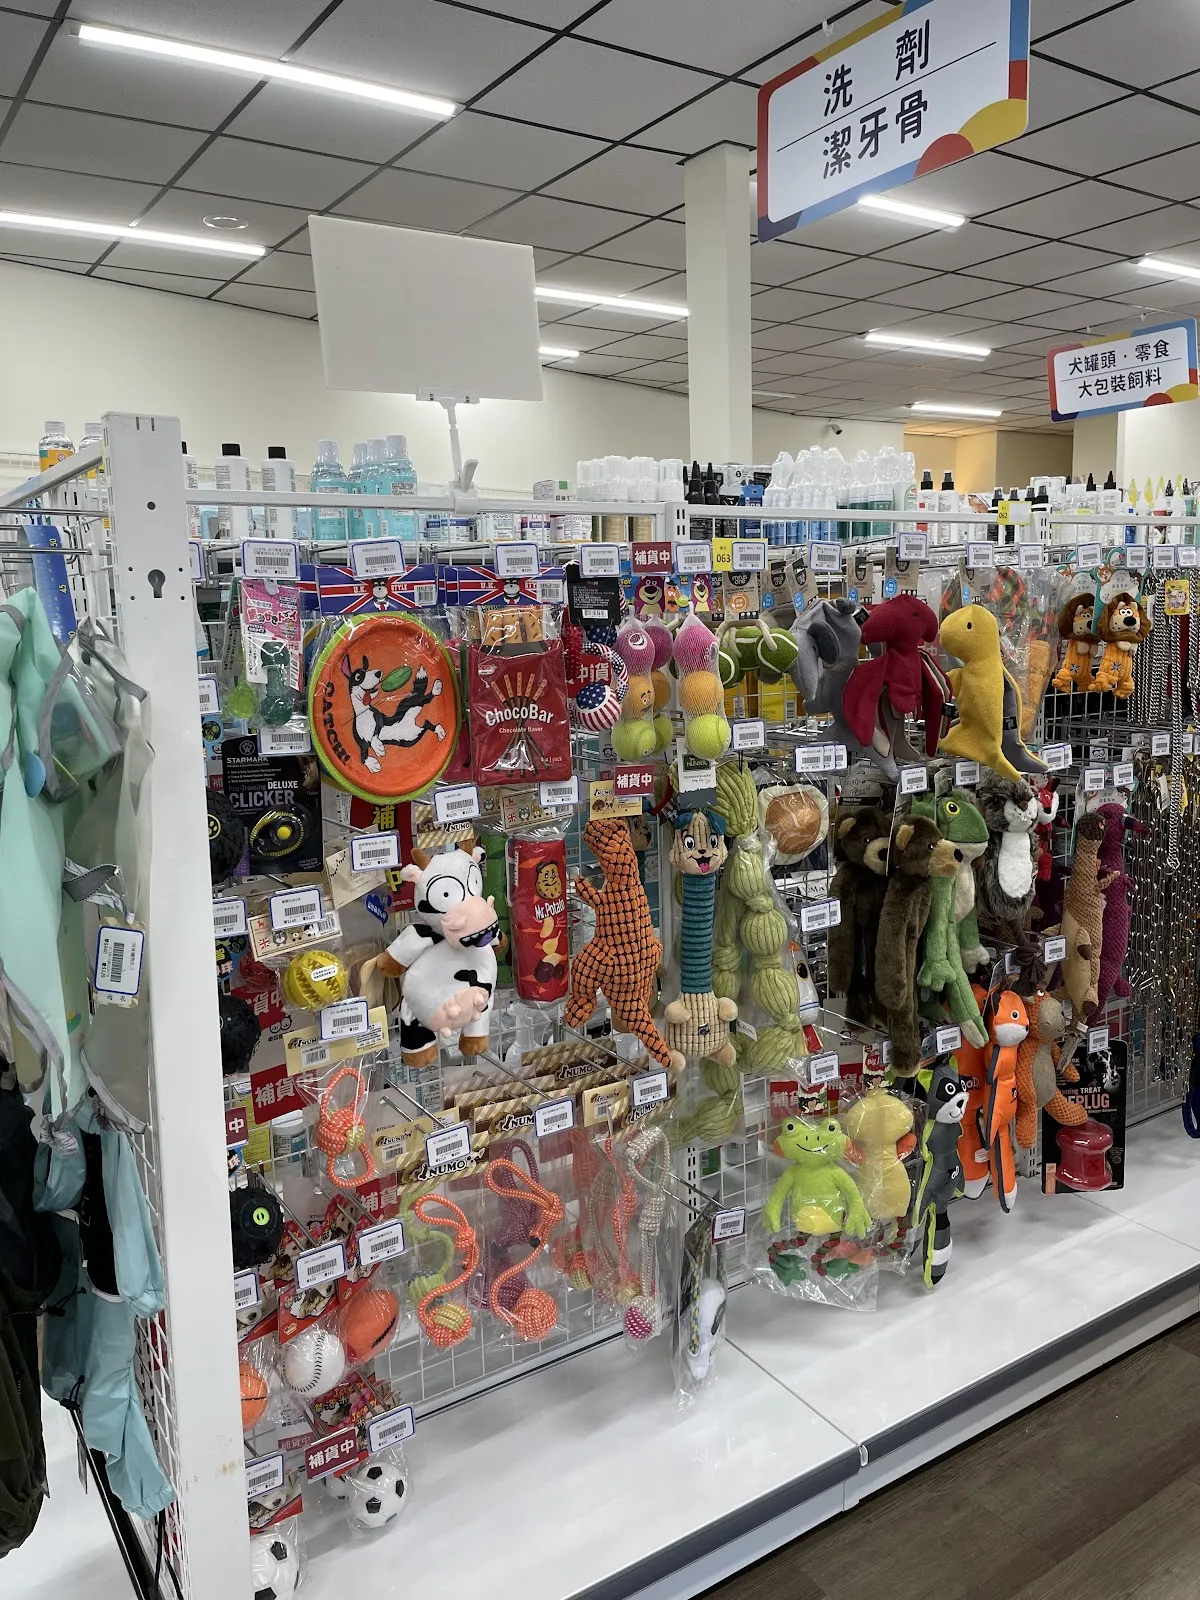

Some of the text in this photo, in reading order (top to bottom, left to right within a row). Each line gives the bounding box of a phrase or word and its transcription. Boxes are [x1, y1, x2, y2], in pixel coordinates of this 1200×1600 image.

[822, 89, 928, 180] 潔牙骨
[1077, 366, 1162, 399] 大包裝飼料
[49, 538, 58, 547] 50
[634, 550, 670, 566] 補貨中
[716, 554, 731, 563] 063
[59, 584, 68, 594] 45
[391, 584, 408, 592] STYLE
[524, 581, 537, 589] STY
[485, 703, 554, 727] ChocoBar
[226, 756, 269, 764] STARMARK
[228, 780, 299, 792] Pro-Training DELUXE
[616, 772, 652, 789] 補貨中
[229, 789, 295, 809] CLICKER
[1064, 1094, 1110, 1110] EPLUG
[511, 1115, 534, 1129] NUM
[429, 1160, 466, 1178] NUMO
[360, 1186, 398, 1213] 補貨
[308, 1439, 355, 1470] 補貨中
